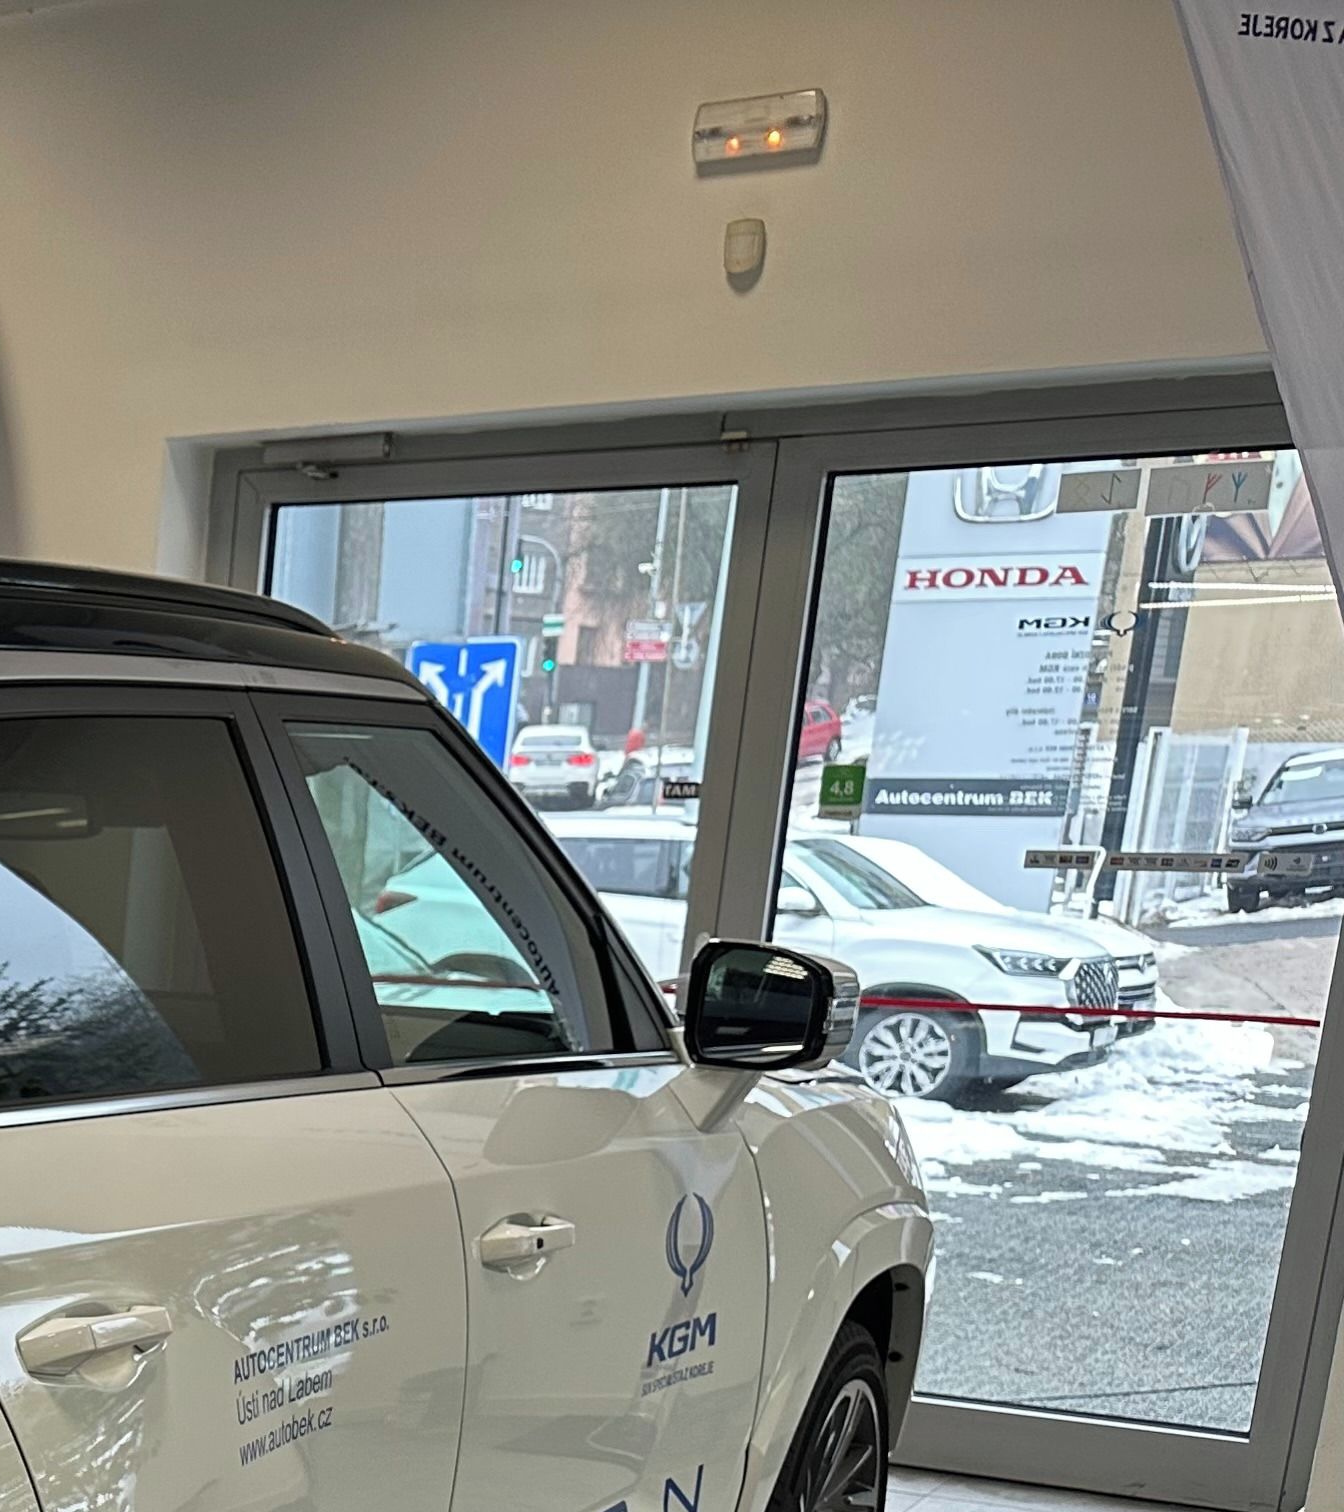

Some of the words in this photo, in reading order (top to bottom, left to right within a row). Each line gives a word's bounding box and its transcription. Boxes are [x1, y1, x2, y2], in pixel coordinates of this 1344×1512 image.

[905, 566, 1089, 590] HONDA
[829, 779, 854, 797] 4,8
[874, 789, 1004, 806] Autocentrum
[1009, 789, 1054, 806] BEK
[234, 1328, 332, 1385] AUTOCENTRUM
[334, 1318, 361, 1348] BEK
[362, 1314, 390, 1339] s.r.o.
[646, 1312, 717, 1368] KGM
[263, 1387, 284, 1412] nad
[288, 1369, 333, 1403] Labem
[239, 1406, 334, 1467] www.autobek.cz
